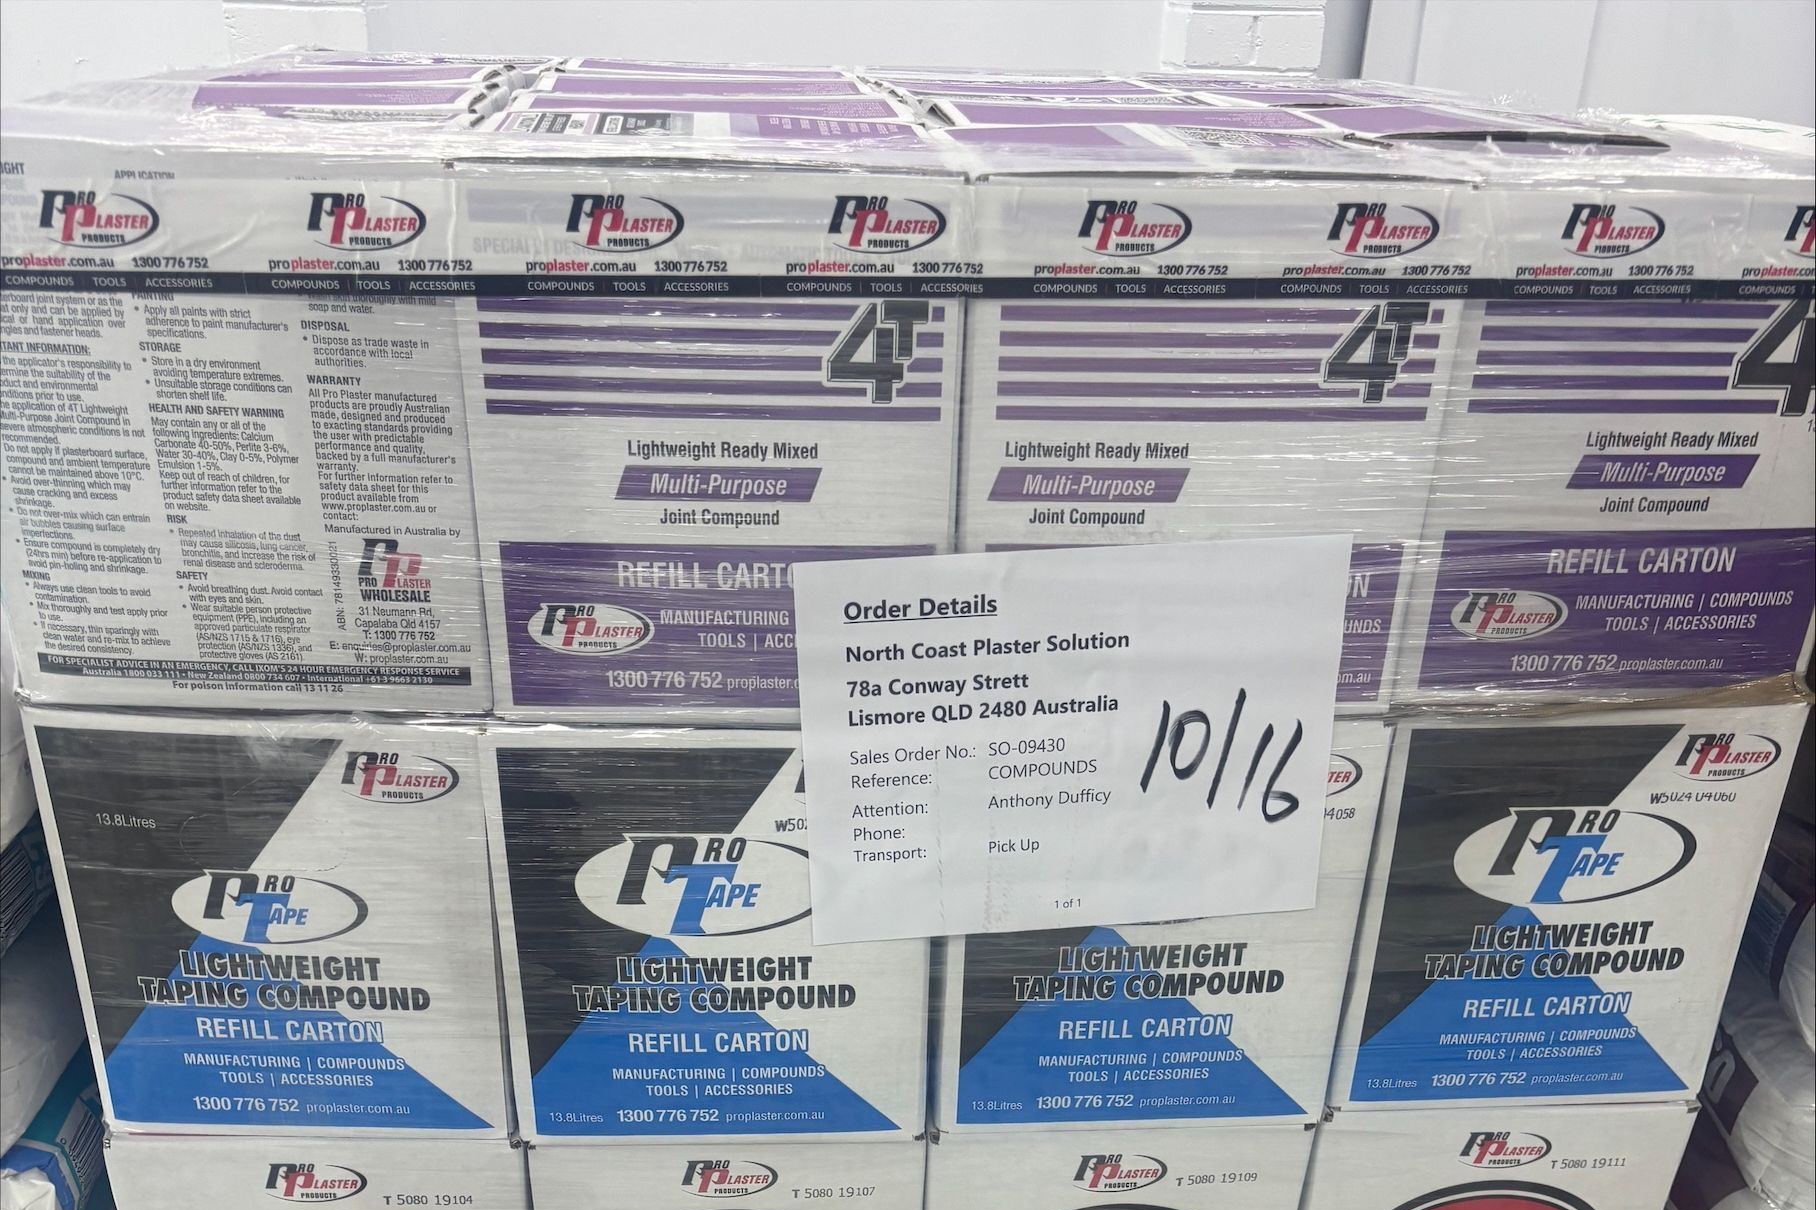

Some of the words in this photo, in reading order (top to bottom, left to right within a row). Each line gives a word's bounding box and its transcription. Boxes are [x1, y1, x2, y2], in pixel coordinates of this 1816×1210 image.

[1034, 263, 1140, 277] proplaster.com.au
[1157, 265, 1184, 276] 1300
[1185, 265, 1208, 276] 776
[1209, 265, 1228, 276] 752
[1033, 283, 1098, 294] COMPOUNDS
[1115, 284, 1146, 294] TOOLS
[1163, 284, 1226, 294] ACCESSORIES
[301, 320, 350, 331] DISPOSAL
[139, 341, 181, 352] STORAGE
[307, 374, 361, 386] WARRANTY
[309, 388, 320, 397] All
[323, 389, 338, 398] Pro
[340, 390, 371, 400] Plaster
[375, 392, 437, 402] manufactured
[149, 403, 183, 414] HEALTH
[185, 405, 203, 415] AND
[207, 406, 239, 416] SAFETY
[242, 408, 284, 418] WARNING
[1005, 441, 1090, 463] Lightweight
[1095, 442, 1141, 462] Ready
[1146, 443, 1189, 460] Mixed
[1022, 475, 1155, 499] Multi-Purpose
[167, 515, 187, 524] RISK
[1029, 508, 1065, 526] Joint
[1069, 509, 1145, 527] Compound
[325, 524, 391, 534] Manufactured
[404, 527, 446, 535] Australia
[449, 528, 460, 538] by
[1547, 548, 1629, 575] REFILL
[1638, 546, 1737, 574] CARTON
[360, 590, 431, 602] WHOLESALE
[1575, 594, 1694, 610] MANUFACTURING
[1710, 591, 1793, 607] COMPOUNDS
[359, 607, 369, 616] 31
[373, 607, 416, 617] Neumann
[420, 609, 434, 618] Rd,
[843, 602, 911, 622] Order
[920, 595, 998, 617] Details
[336, 608, 347, 631] ABN:
[355, 619, 397, 629] Capalaba
[401, 620, 416, 628] Qld
[419, 620, 440, 628] 4157
[1605, 616, 1648, 632] TOOLS
[1664, 614, 1756, 630] ACCESSORIES
[363, 631, 372, 639] T:
[374, 631, 396, 640] 1300
[400, 631, 416, 640] 776
[419, 632, 435, 640] 752
[845, 644, 905, 663] North
[911, 640, 967, 661] Coast
[974, 636, 1041, 657] Plaster
[1046, 632, 1130, 653] Solution
[846, 680, 882, 699] 78a
[888, 676, 967, 699] Conway
[973, 673, 1029, 693] Strett
[848, 707, 926, 727] Lismore
[932, 704, 973, 725] QLD
[979, 700, 1026, 719] 2480
[1032, 695, 1119, 717] Australia
[850, 748, 889, 766] Sales
[894, 746, 940, 763] Order
[946, 744, 976, 760] No.:
[988, 737, 1065, 757] SO-09430
[851, 771, 932, 789] Reference:
[988, 759, 1098, 780] COMPOUNDS
[382, 791, 424, 800] PRODUCTS
[852, 800, 928, 818] Attention:
[988, 789, 1053, 812] Anthony
[1058, 787, 1111, 806] Dufficy
[95, 812, 156, 829] 13.8Litres
[853, 825, 906, 842] Phone:
[854, 846, 927, 864] Transport:
[988, 838, 1015, 854] Pick
[1020, 837, 1040, 855] Up
[1055, 900, 1059, 908] 1
[1062, 899, 1075, 908] of
[1077, 898, 1081, 907] 1
[616, 955, 812, 984] LIGHTWEIGHT
[573, 985, 681, 1012] TAPING
[689, 983, 856, 1013] COMPOUND
[628, 1032, 707, 1053] REFILL
[715, 1029, 809, 1052] CARTON
[612, 1067, 726, 1080] MANUFACTURING
[741, 1065, 825, 1078] COMPOUNDS
[646, 1084, 688, 1097] TOOLS
[704, 1083, 793, 1096] ACCESSORIES
[549, 1111, 603, 1123] 13.8Litres
[616, 1109, 656, 1123] 1300
[657, 1109, 687, 1122] 776
[689, 1108, 719, 1122] 752
[726, 1109, 825, 1123] proplaster.com.au
[1551, 1160, 1558, 1169] T
[1561, 1157, 1587, 1169] 5080
[1591, 1157, 1626, 1169] 19111
[1176, 1178, 1183, 1186] T
[1187, 1174, 1215, 1185] 5080
[1220, 1172, 1258, 1183] 19109
[383, 1197, 391, 1205] T
[396, 1195, 428, 1206] 5080
[434, 1194, 473, 1206] 19104
[792, 1189, 800, 1198] T
[804, 1187, 833, 1199] 5080
[838, 1186, 876, 1198] 19107
